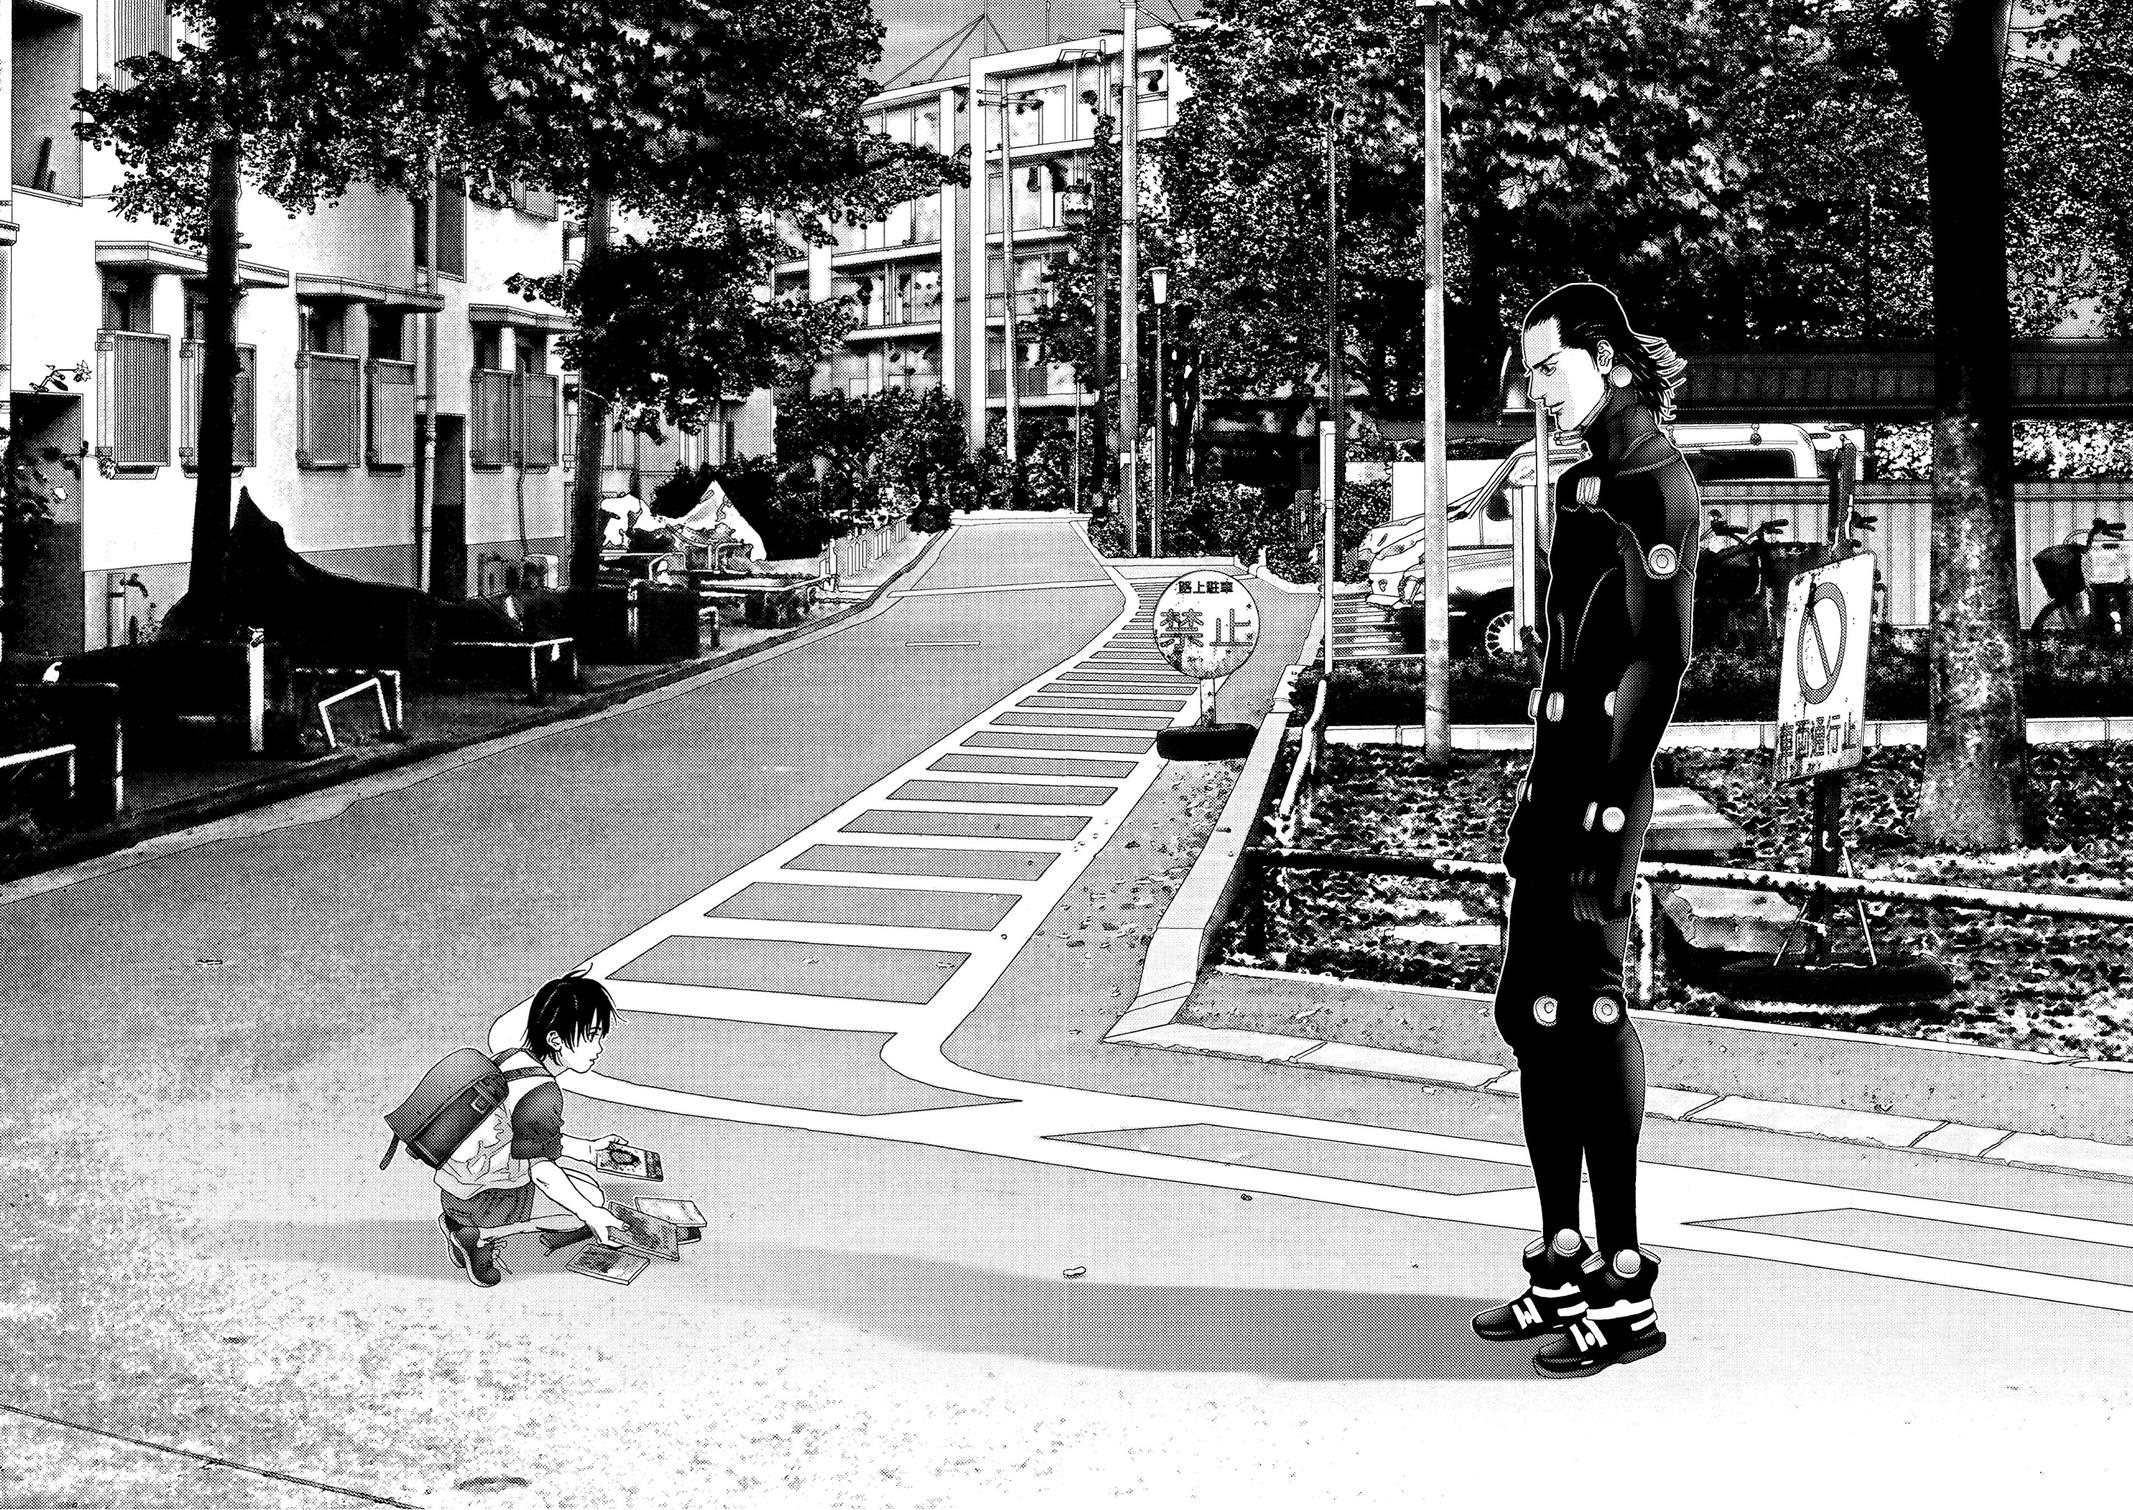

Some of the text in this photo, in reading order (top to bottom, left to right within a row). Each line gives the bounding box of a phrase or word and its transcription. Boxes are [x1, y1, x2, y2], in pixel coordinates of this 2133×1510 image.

[1178, 580, 1234, 595] 路上駐車
[1159, 608, 1254, 650] 禁止
